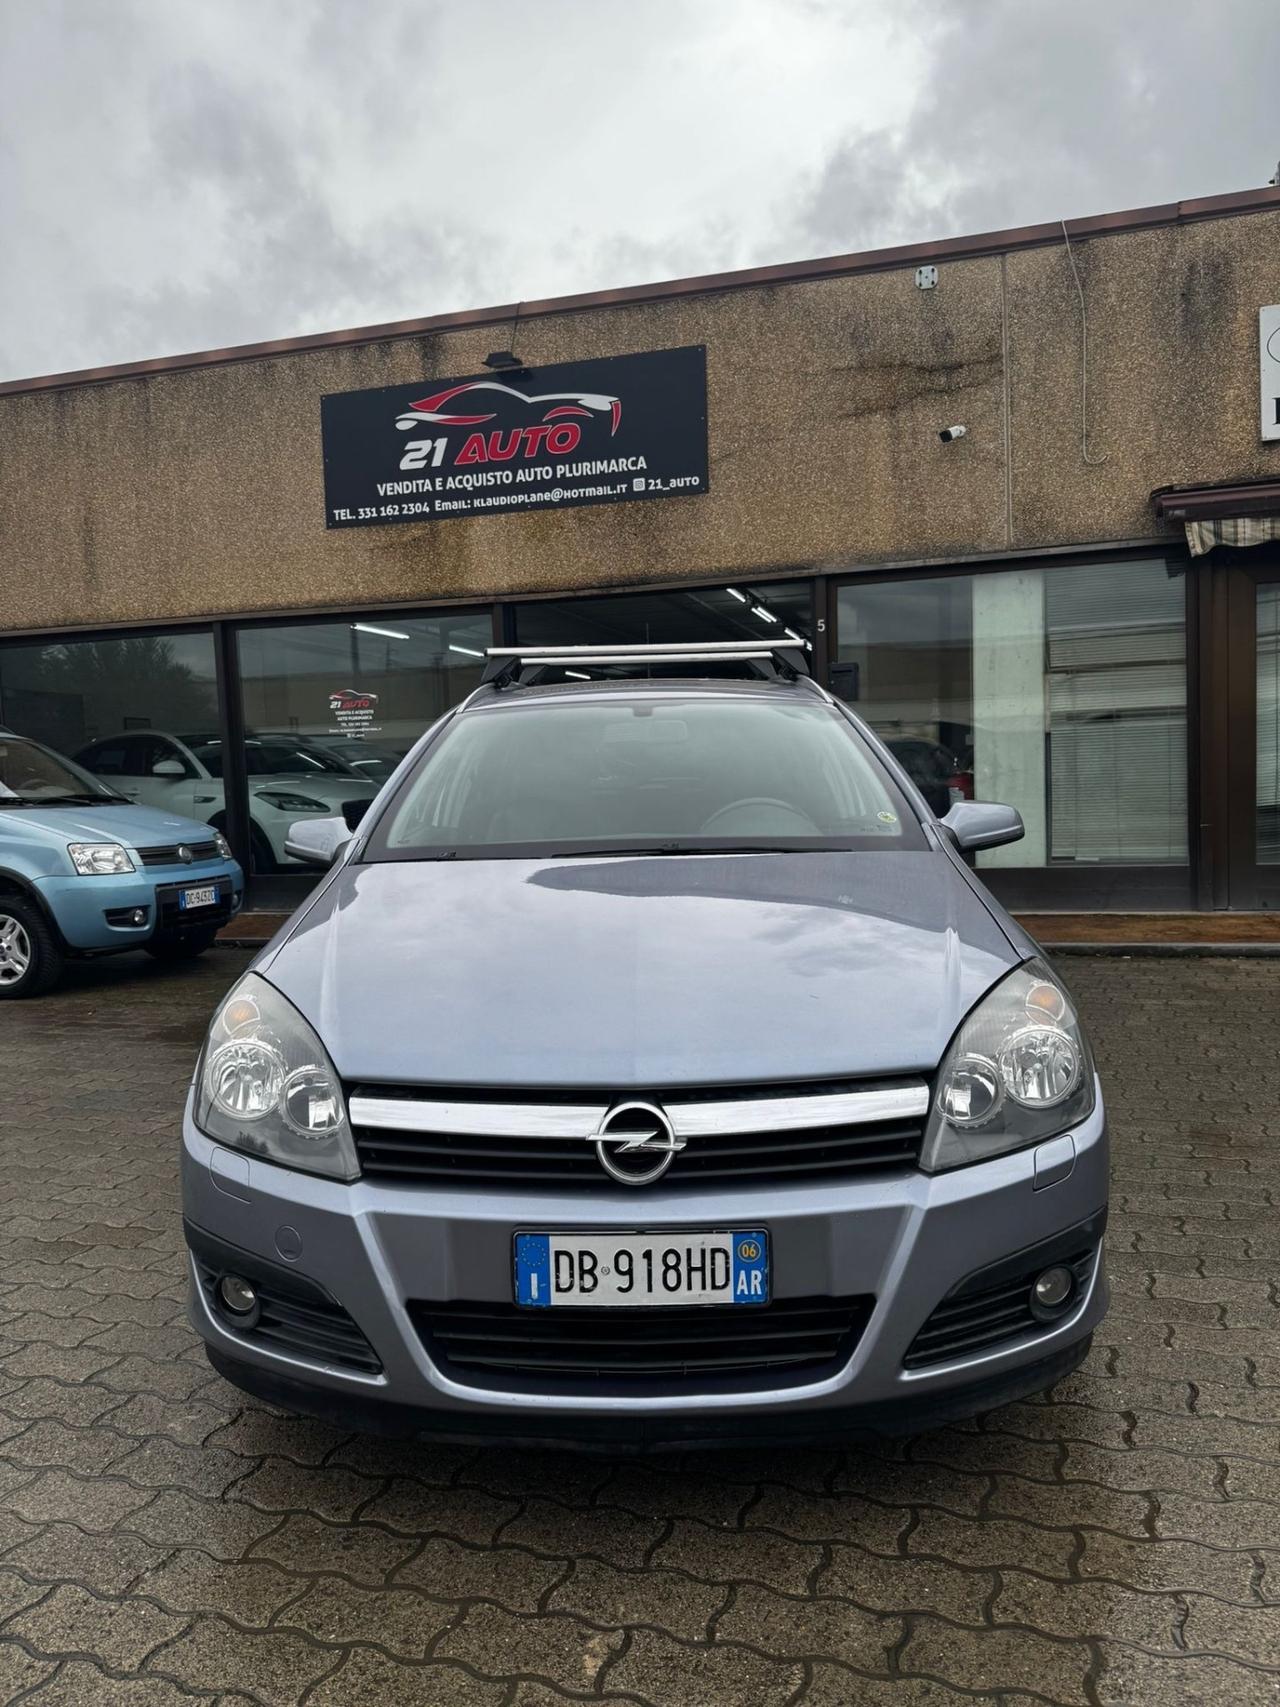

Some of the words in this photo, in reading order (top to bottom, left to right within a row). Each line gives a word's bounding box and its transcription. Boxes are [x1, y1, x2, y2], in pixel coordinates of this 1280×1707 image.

[399, 437, 448, 471] 21
[454, 422, 581, 466] AUTO
[376, 478, 433, 497] VENDITA
[435, 477, 443, 491] E
[446, 470, 513, 491] ACQUISTO
[515, 466, 553, 483] AUTO
[556, 456, 648, 479] PLURIMARCA
[333, 508, 356, 521] TEL.
[358, 506, 378, 520] 331
[380, 504, 400, 517] 162
[401, 502, 430, 516] 2304
[817, 619, 826, 632] 5
[330, 701, 341, 709] 21
[342, 700, 369, 709] AUTO
[741, 1243, 757, 1258] 06
[530, 1273, 538, 1300] I
[554, 1250, 599, 1293] DB
[613, 1247, 731, 1293] 918HD
[736, 1270, 762, 1296] AR
